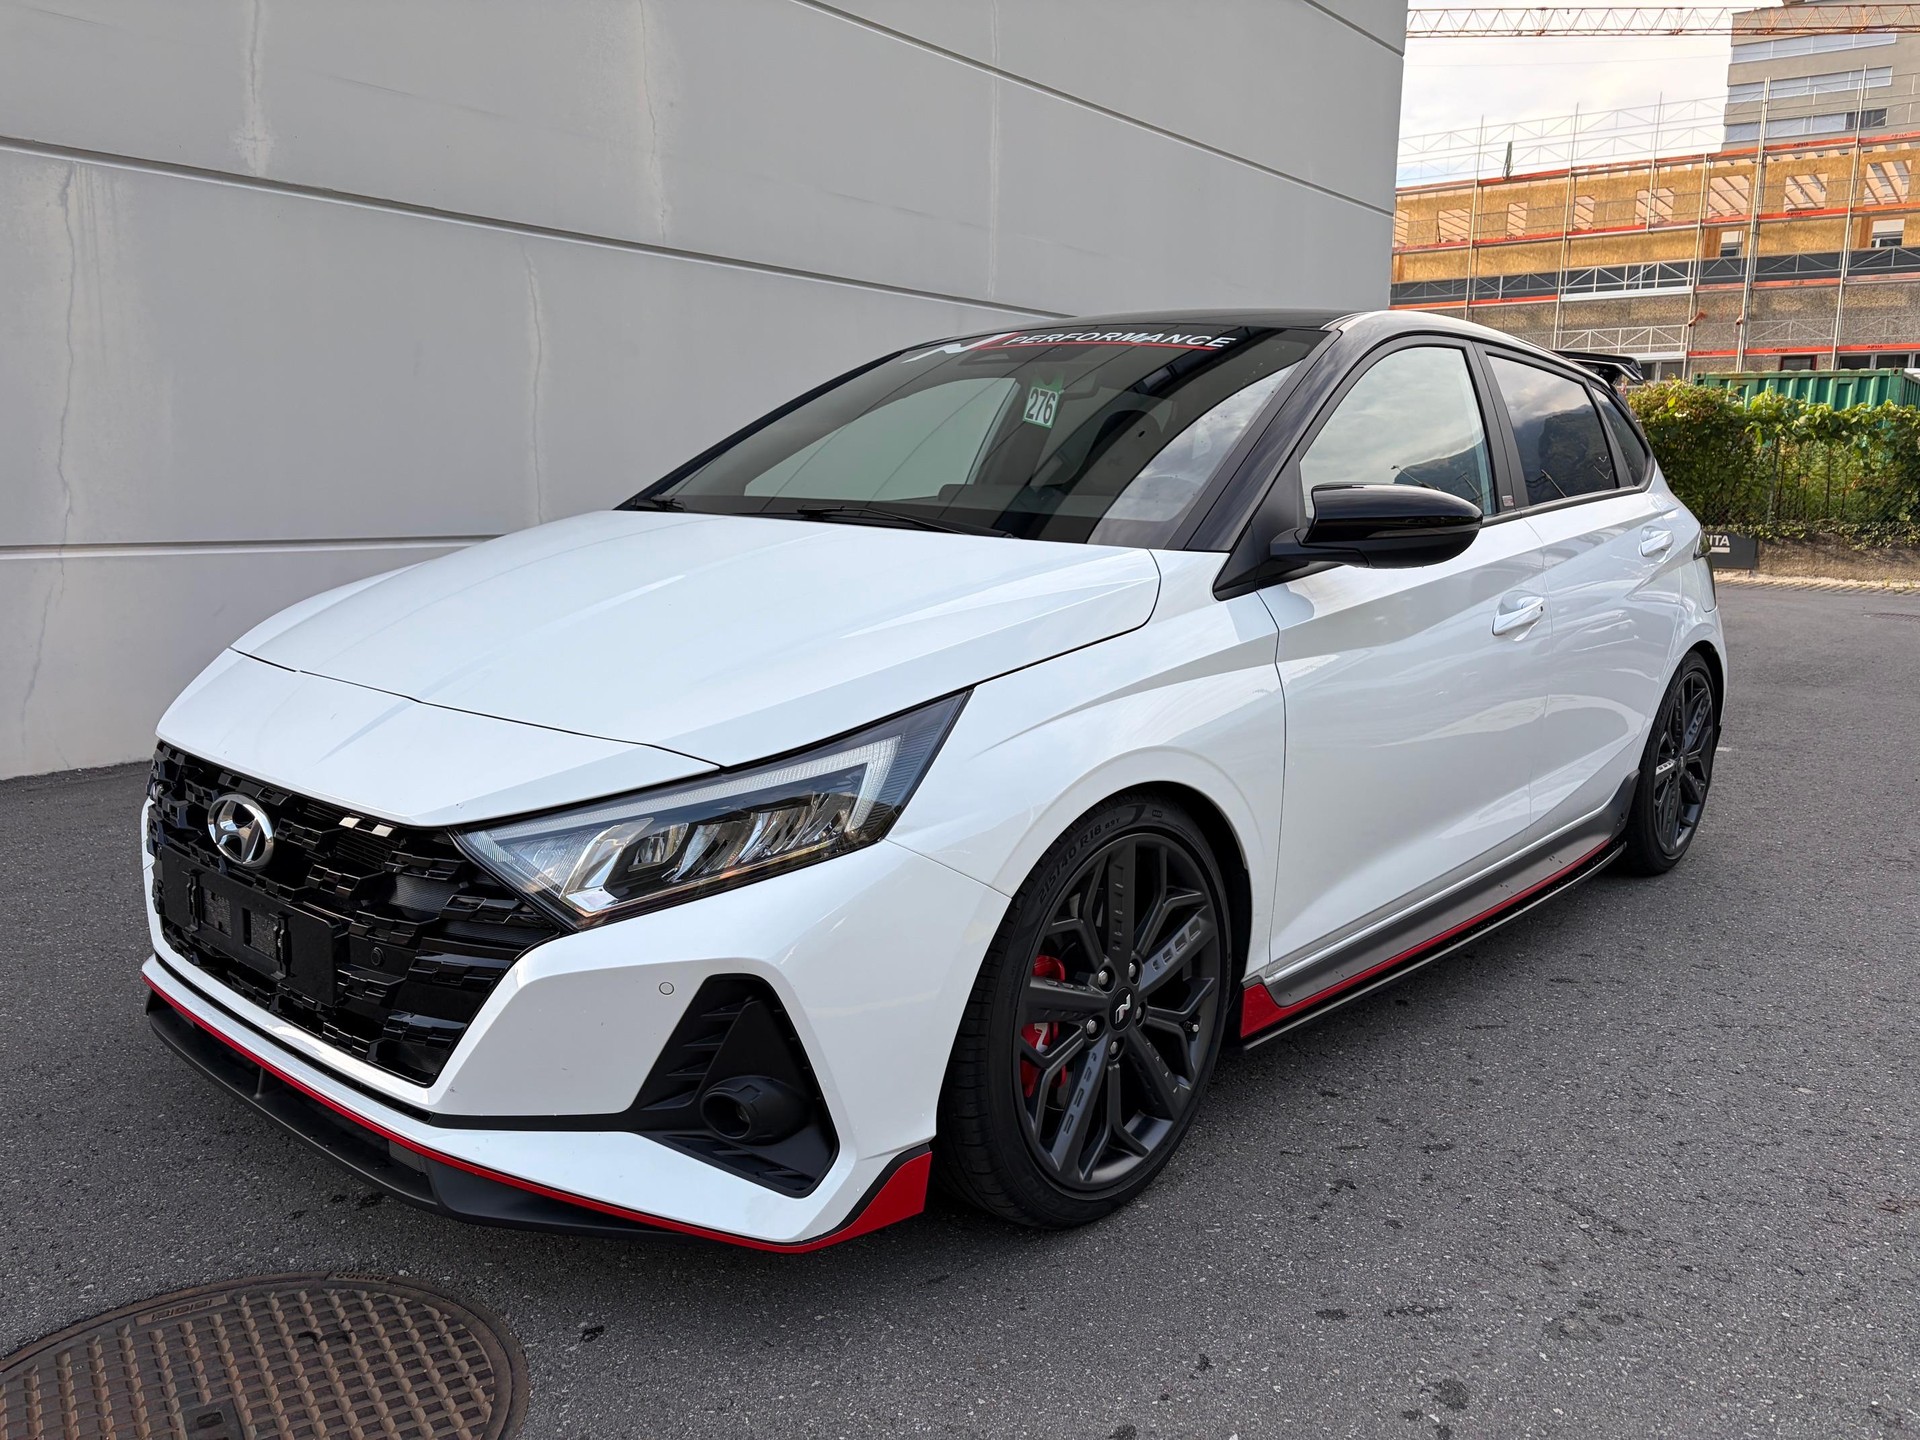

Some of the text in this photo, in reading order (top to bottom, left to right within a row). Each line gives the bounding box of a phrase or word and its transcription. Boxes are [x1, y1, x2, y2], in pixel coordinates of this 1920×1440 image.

[1002, 332, 1237, 348] PERFORMANCE
[1025, 387, 1056, 424] 276
[1706, 534, 1730, 546] ITA
